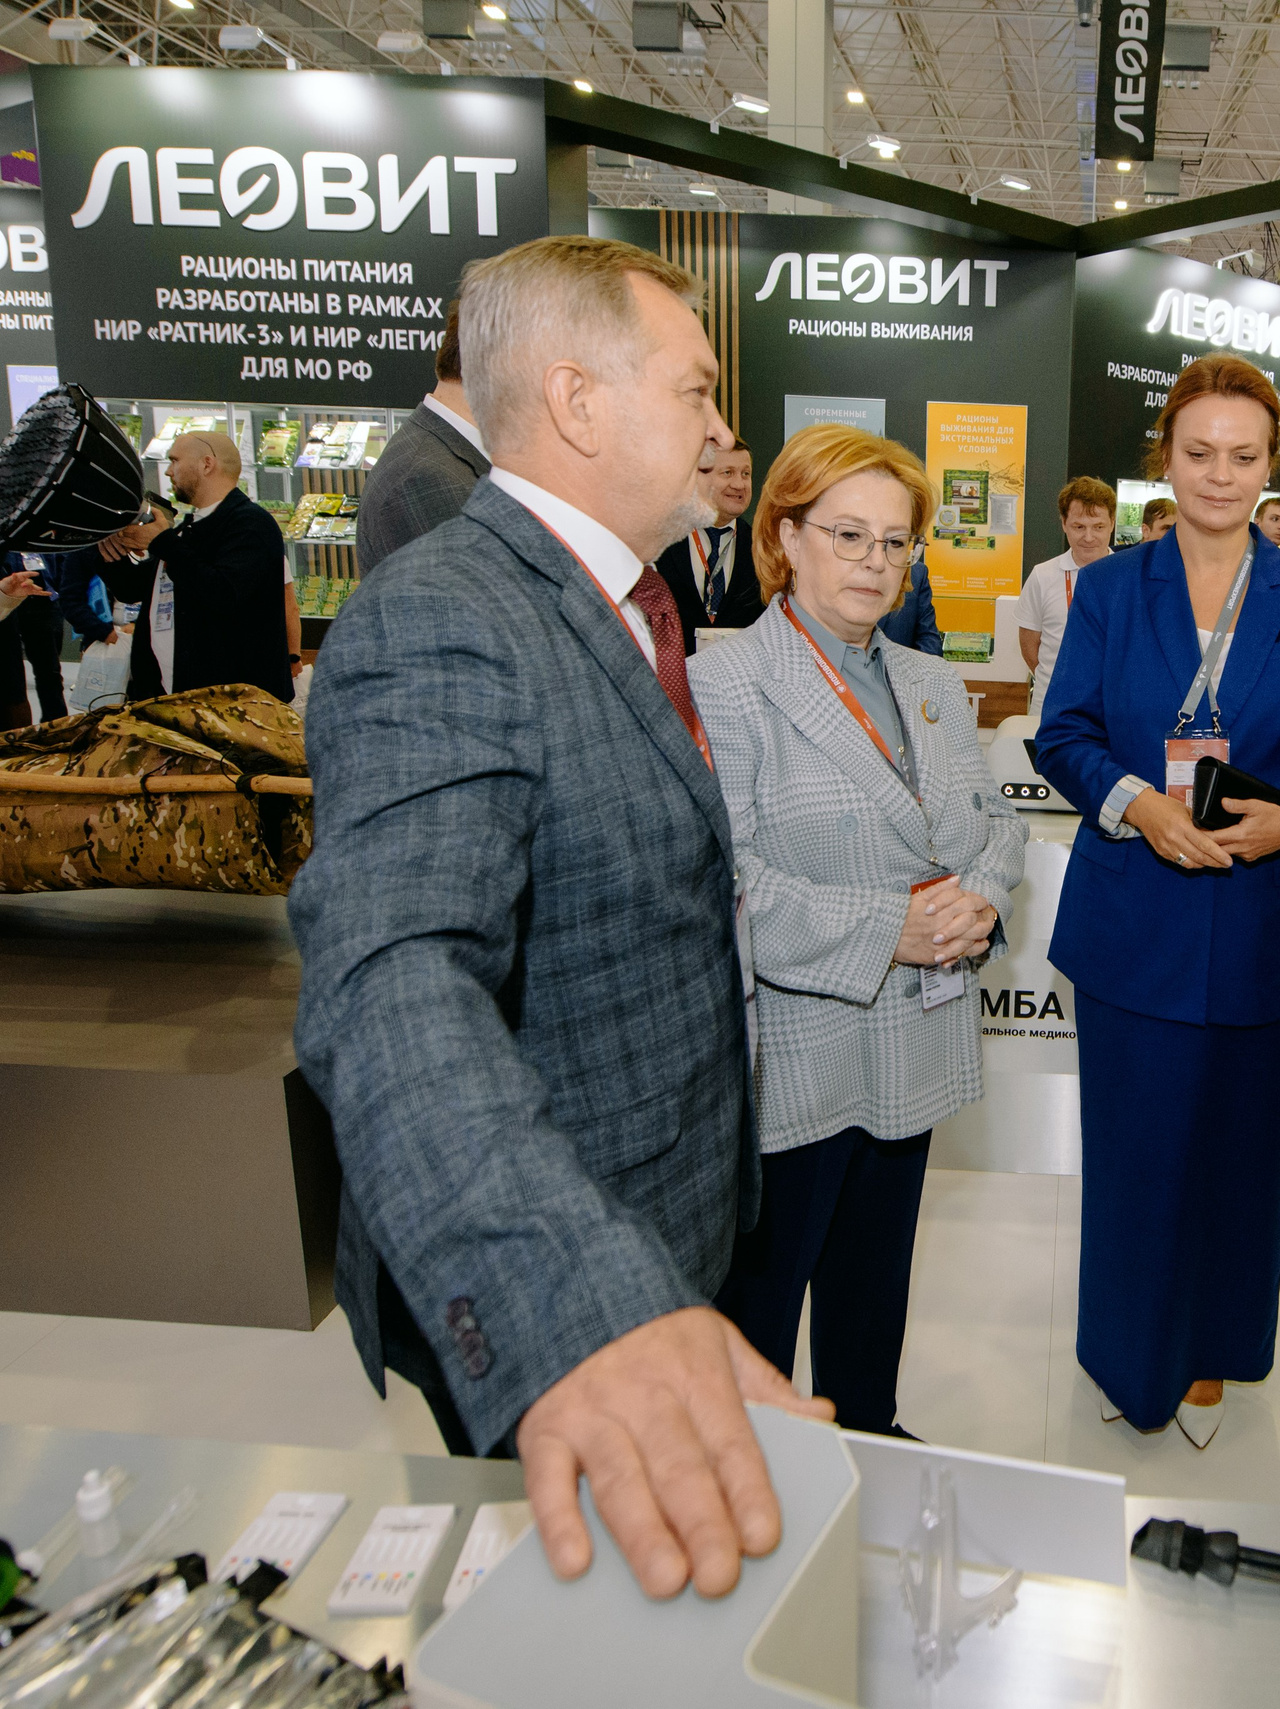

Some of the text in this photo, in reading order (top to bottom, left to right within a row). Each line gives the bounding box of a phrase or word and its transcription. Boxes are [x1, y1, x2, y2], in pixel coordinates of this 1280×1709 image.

[1113, 0, 1150, 143] ЛЕОВ
[71, 145, 517, 236] ЛЕОВИТ
[181, 255, 414, 285] РАЦИОНЫ ПИТАНИЯ
[755, 252, 1010, 307] ЛЕОВИТ
[155, 287, 444, 319] РАЗРАБОТАНЫ В РАМКАХ
[22, 313, 54, 331] ПИТ
[788, 318, 974, 342] РАЦИОНЫ ВЫЖИВАНИЯ
[94, 319, 142, 341] НИР
[147, 322, 284, 346] «РАТНИК-3»
[290, 325, 307, 347] И
[313, 326, 361, 349] НИР
[240, 356, 373, 382] ДЛЯ МО РФ
[1144, 391, 1168, 408] ДЛЯ
[804, 407, 867, 419] СОВРЕМЕННЫЕ
[956, 414, 999, 424] РАЦИОНЫ
[940, 423, 1015, 435] ВЫЖИВАНИЯ ДЛЯ
[1145, 429, 1158, 439] ФСБ
[939, 433, 1014, 445] ЭКСТРЕМАЛЬНЫХ
[958, 444, 998, 454] УСЛОВИЙ
[980, 1027, 1026, 1037] альное
